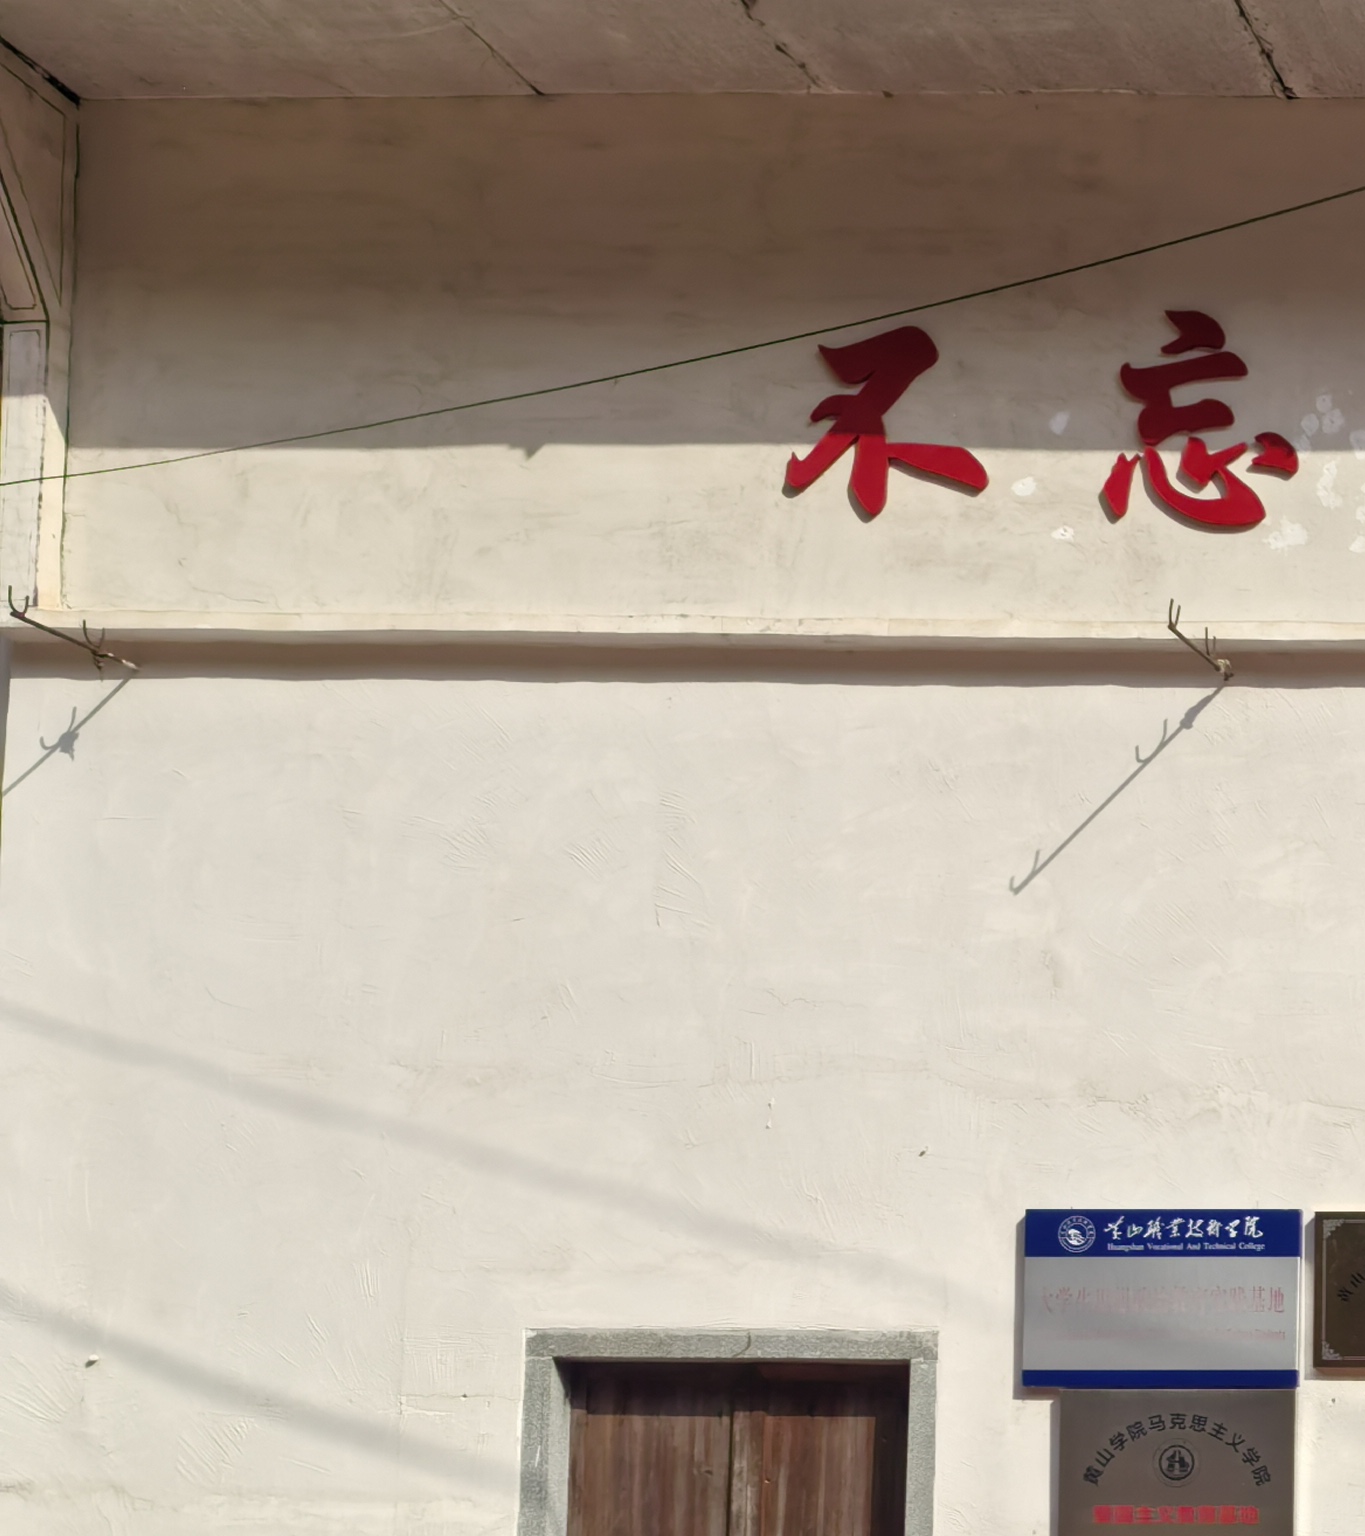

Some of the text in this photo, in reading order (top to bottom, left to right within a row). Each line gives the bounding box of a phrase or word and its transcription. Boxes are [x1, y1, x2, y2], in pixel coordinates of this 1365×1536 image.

[1107, 1242, 1266, 1252] Huangshan Vocational And Technical College
[1083, 1412, 1272, 1487] 黄山学院马克思主义学院
